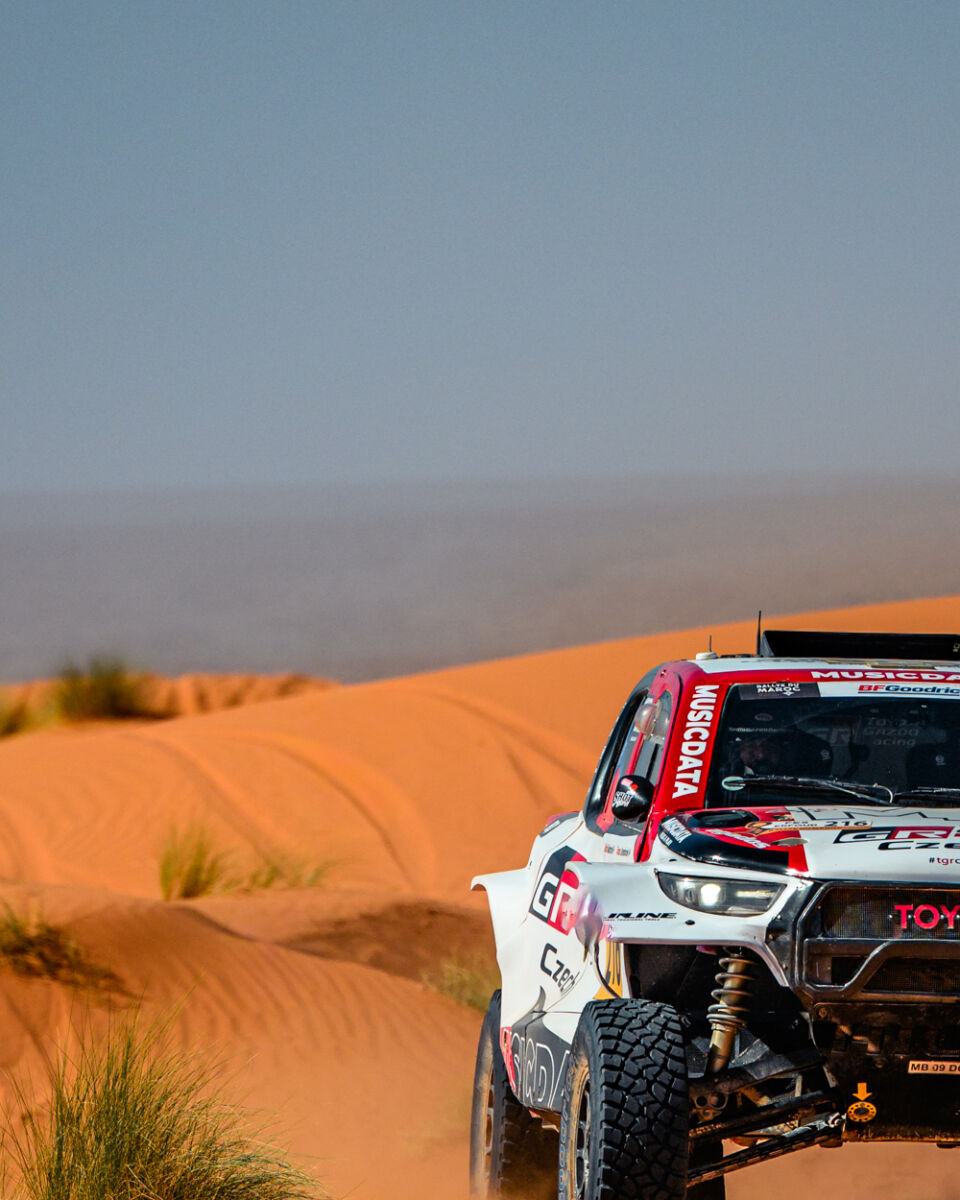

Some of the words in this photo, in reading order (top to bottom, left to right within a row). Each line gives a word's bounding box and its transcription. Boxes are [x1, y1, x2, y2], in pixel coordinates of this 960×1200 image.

[671, 684, 720, 799] MUSICDATA
[836, 827, 951, 843] GR
[910, 1063, 929, 1072] MB
[931, 1063, 946, 1072] 09
